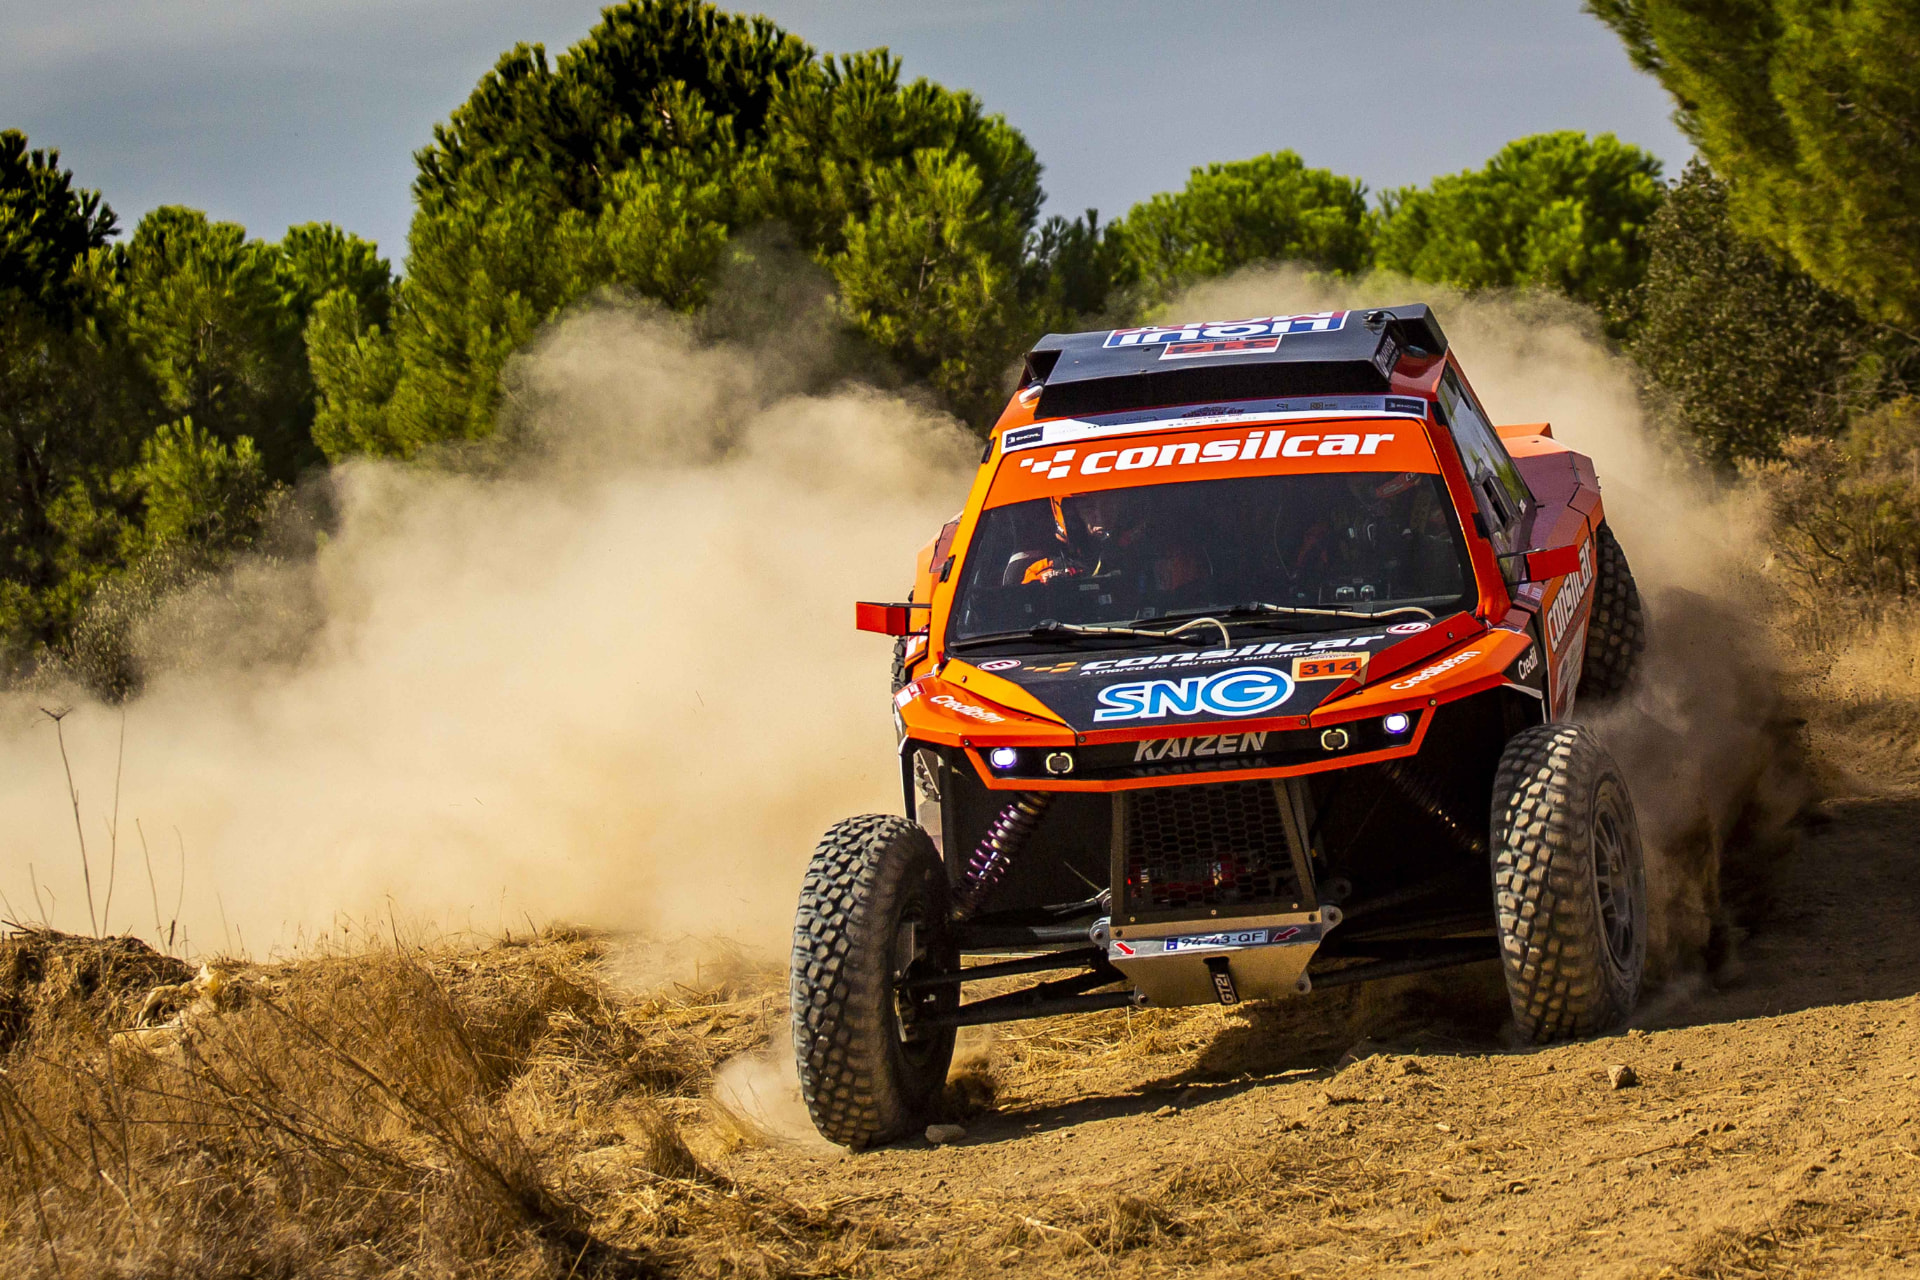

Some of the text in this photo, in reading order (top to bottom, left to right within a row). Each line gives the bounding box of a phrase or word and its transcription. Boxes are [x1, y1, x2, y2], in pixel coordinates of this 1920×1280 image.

[1118, 318, 1332, 345] LIQUI
[1080, 430, 1395, 476] consilcar
[1081, 635, 1386, 670] consilcar
[1202, 657, 1239, 665] novo
[1302, 661, 1359, 675] 314
[1095, 667, 1294, 721] SNG
[1134, 731, 1268, 762] KAIZEN
